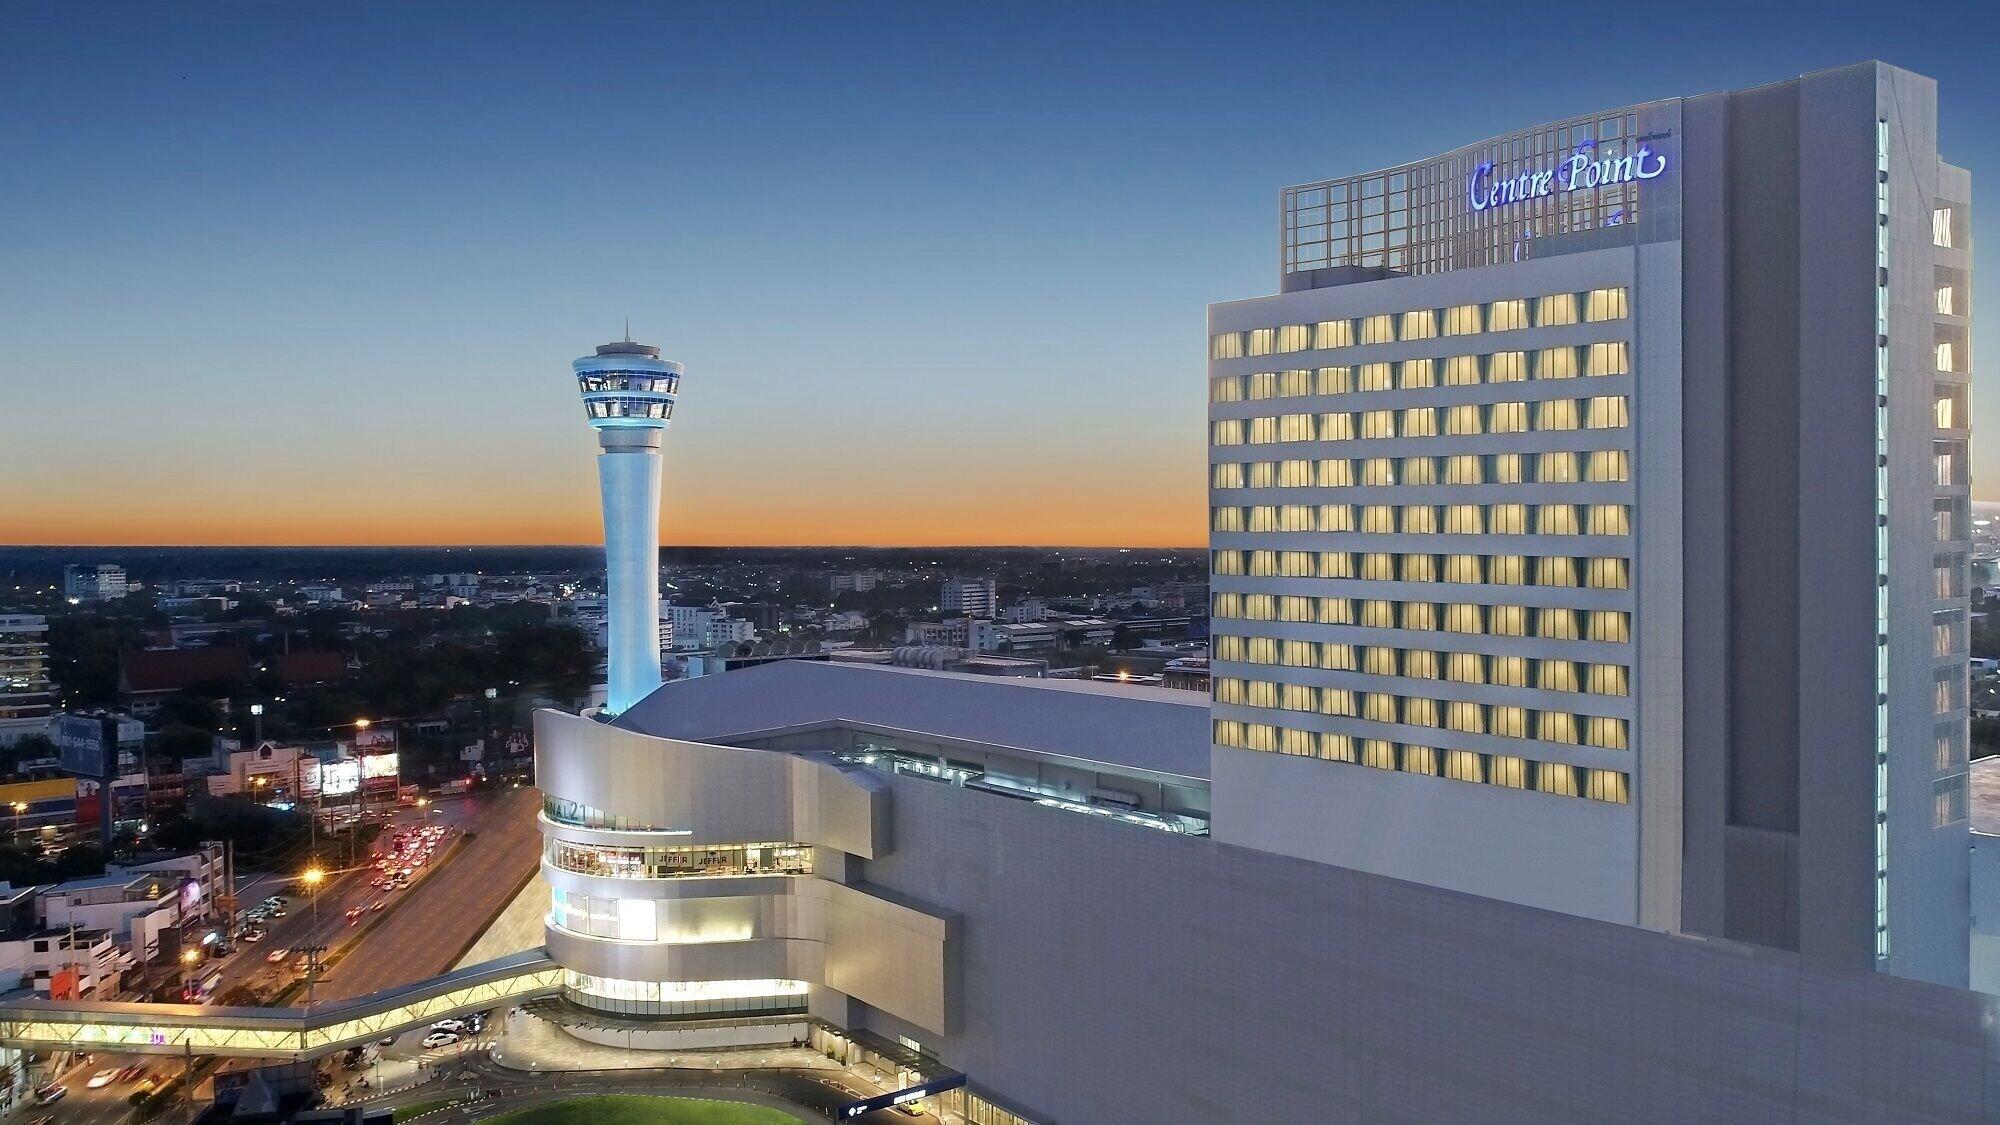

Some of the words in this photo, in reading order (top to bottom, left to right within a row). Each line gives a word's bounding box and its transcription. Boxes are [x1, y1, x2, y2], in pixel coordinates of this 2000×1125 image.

[1470, 160, 1553, 210] Centre
[1557, 140, 1666, 192] Point
[570, 801, 586, 821] 21
